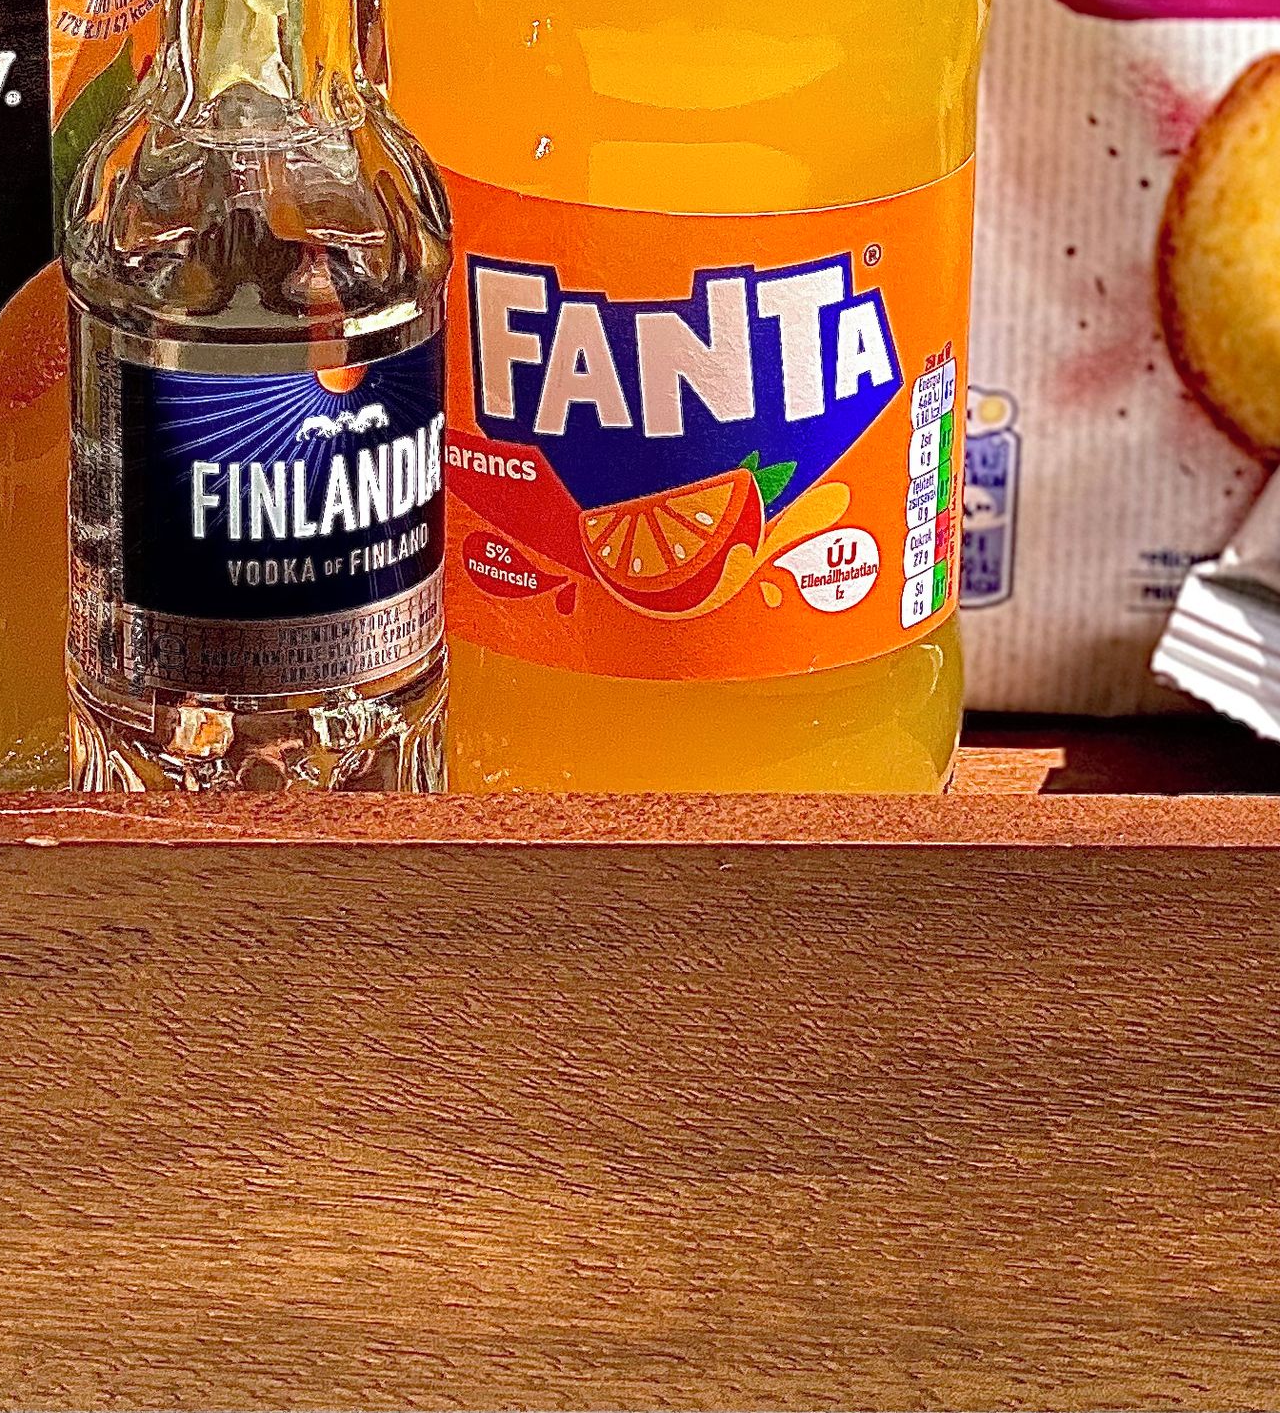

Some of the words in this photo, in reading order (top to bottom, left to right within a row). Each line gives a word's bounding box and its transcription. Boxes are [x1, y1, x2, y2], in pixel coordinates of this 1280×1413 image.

[473, 263, 897, 439] FANTA
[228, 556, 317, 587] VODKA
[324, 557, 344, 578] OF
[350, 522, 430, 577] FINLAND
[484, 541, 513, 565] 5%
[826, 537, 858, 568] ÚJ
[467, 557, 539, 591] narancslé
